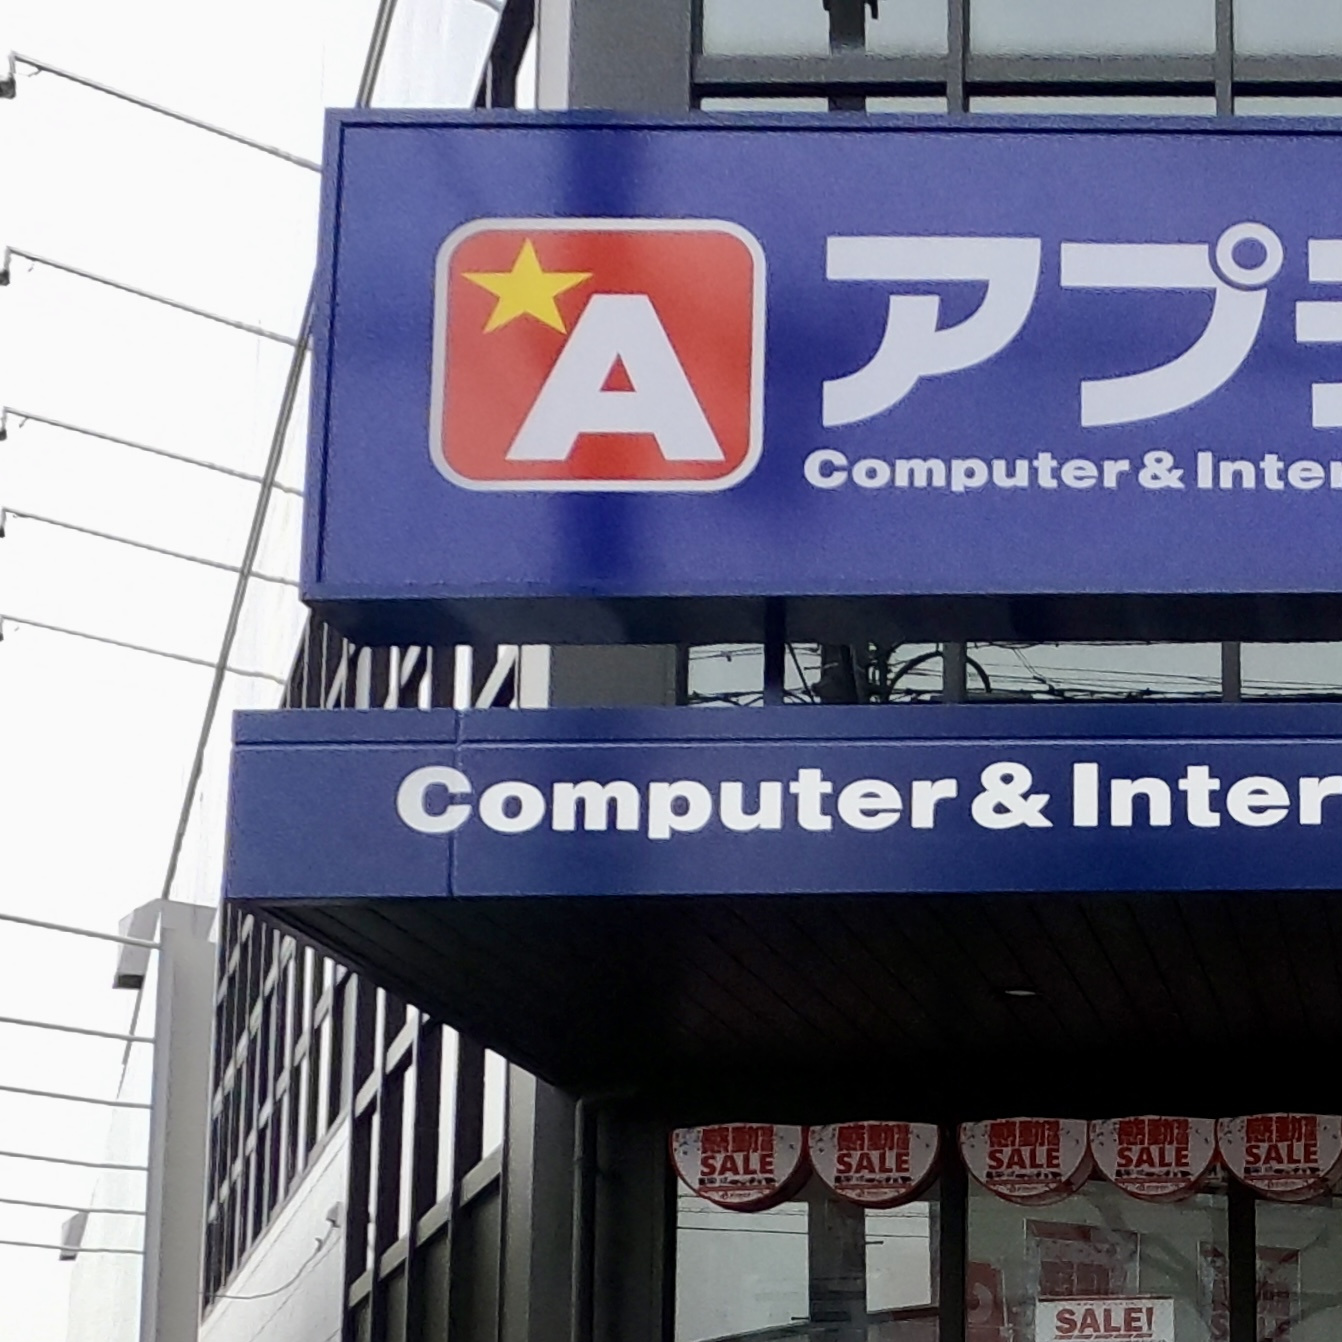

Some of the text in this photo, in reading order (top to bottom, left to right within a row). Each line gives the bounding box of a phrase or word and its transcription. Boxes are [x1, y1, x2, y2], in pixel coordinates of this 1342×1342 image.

[505, 294, 725, 463] A
[700, 1152, 773, 1176] SALE
[836, 1152, 910, 1174] SALE
[988, 1147, 1060, 1170] SALE
[1117, 1147, 1189, 1168] SALE
[1245, 1141, 1318, 1164] SALE
[1055, 1307, 1154, 1335] SALE!
